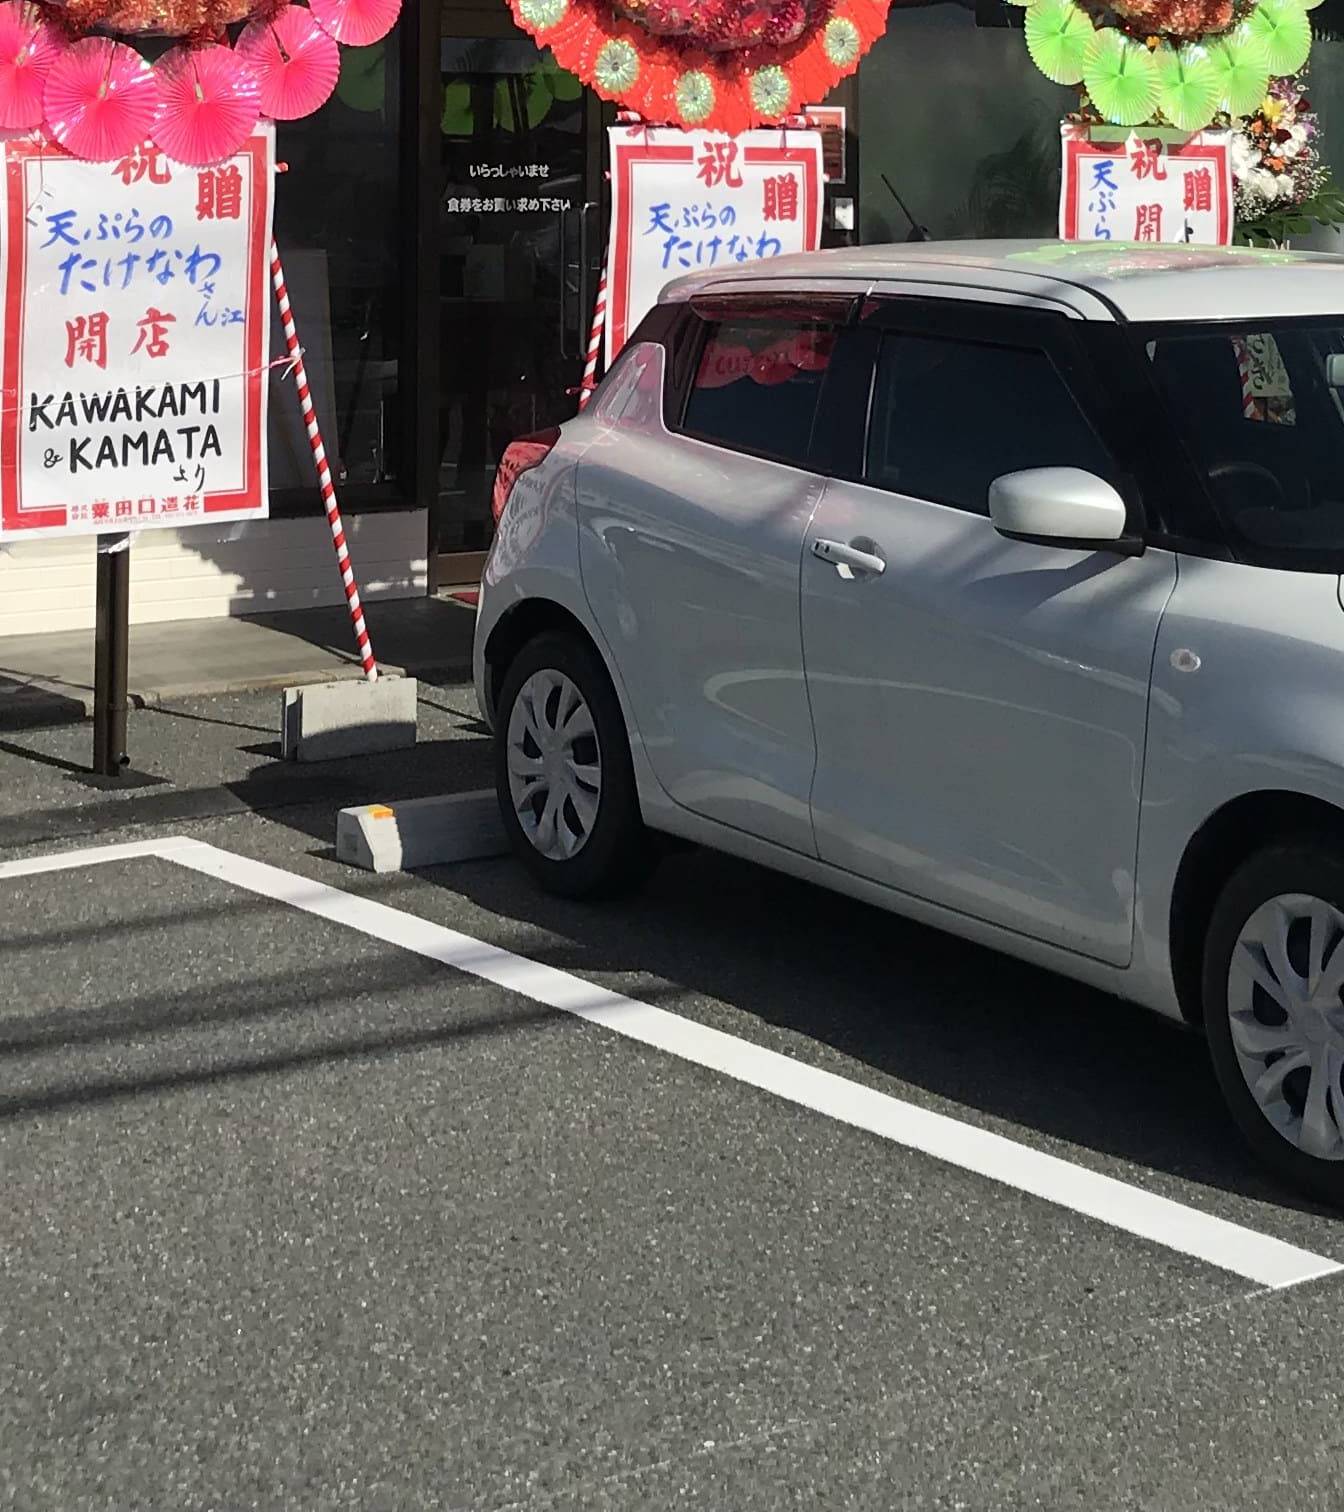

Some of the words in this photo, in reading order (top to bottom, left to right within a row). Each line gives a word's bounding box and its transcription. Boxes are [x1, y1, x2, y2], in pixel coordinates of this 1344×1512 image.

[111, 145, 173, 185] 祝
[469, 164, 550, 178] いらっしゃいませ
[696, 140, 744, 189] 祝
[1130, 137, 1168, 181] 祝
[196, 164, 243, 221] 贈
[447, 197, 571, 213] 食券をお買い求め下さい
[762, 172, 799, 222] 贈
[1088, 159, 1119, 241] 天ぷら
[1183, 167, 1212, 212] 贈
[40, 208, 173, 249] 天ぷらの
[642, 202, 737, 236] 天ぷらの
[58, 244, 222, 295] たけなわ
[662, 230, 782, 270] たけなわ
[64, 307, 177, 370] 開店
[29, 378, 220, 432] KAWAKAMI
[43, 448, 64, 468] &
[70, 424, 222, 474] KAMATA
[173, 464, 206, 492] より
